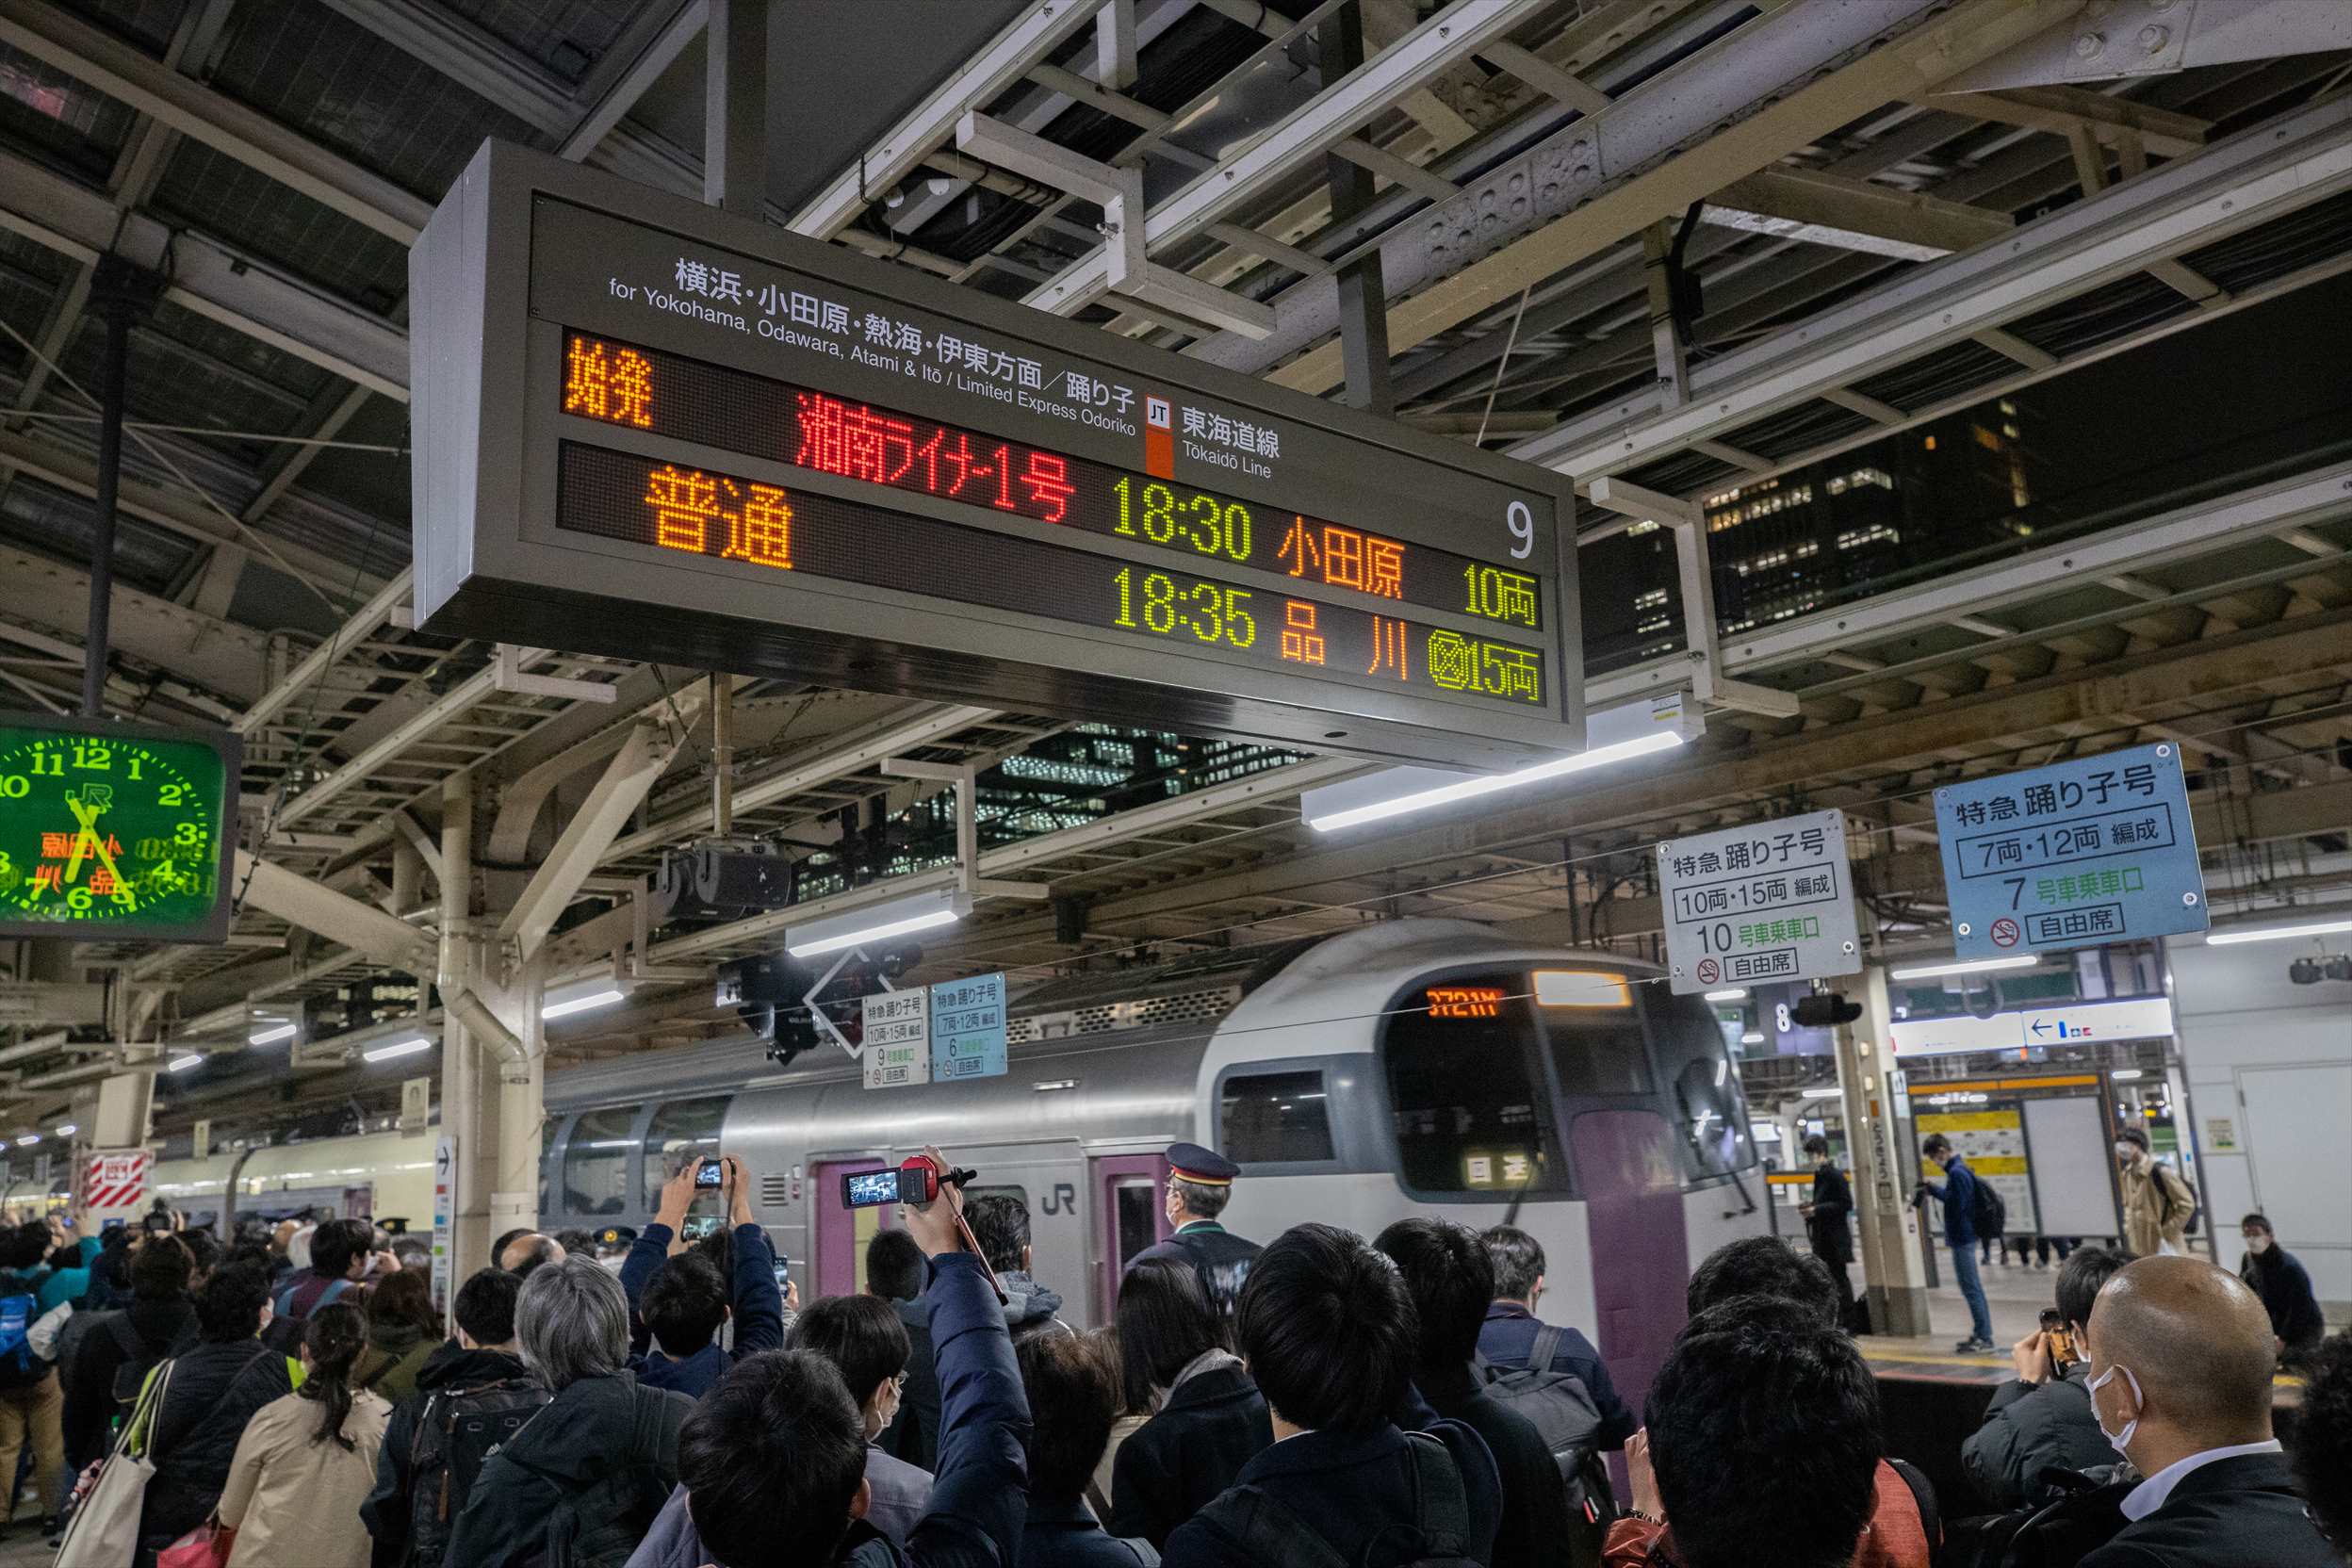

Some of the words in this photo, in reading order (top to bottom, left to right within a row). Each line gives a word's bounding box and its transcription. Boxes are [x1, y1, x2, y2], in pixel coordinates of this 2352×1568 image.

[609, 278, 637, 301] for
[644, 286, 751, 335] Yokohama,
[758, 319, 844, 360] Odawara,
[851, 345, 899, 373] Atami
[905, 361, 917, 378] &
[923, 364, 942, 384] Itō
[956, 376, 1013, 403] Limited
[1018, 391, 1077, 421] Express
[1081, 408, 1136, 437] Odoriko
[1151, 404, 1167, 421] JT
[1182, 406, 1281, 459] 東海道線
[1182, 439, 1238, 469] Tōkaidō
[1242, 456, 1272, 479] Line
[565, 336, 653, 429] 始発
[1113, 477, 1251, 561] 18:30
[1277, 515, 1405, 599] 小田原
[1463, 564, 1536, 626] 10両
[1507, 499, 1534, 559] 9
[645, 466, 793, 569] 普通
[1113, 567, 1256, 647] 18:35
[30, 753, 65, 776] 11
[73, 746, 111, 770] 12
[127, 759, 142, 780] 1
[158, 785, 182, 806] 2
[1956, 796, 2019, 826] 特急
[2024, 763, 2156, 816] 踊り子号
[174, 823, 198, 845] 3
[1978, 825, 2100, 868] 7両・12両
[2111, 818, 2159, 845] 編成
[1674, 852, 1723, 878] 特急
[1725, 828, 1825, 871] 踊り子号
[152, 860, 176, 881] 4
[25, 878, 51, 901] 7
[67, 888, 92, 909] 6
[1682, 878, 1787, 915] 10両・15両
[1794, 874, 1830, 897] 編成
[2003, 877, 2026, 910] 7
[2036, 867, 2144, 905] 号車乗車口
[1697, 923, 1732, 954] 10
[1739, 917, 1820, 948] 号車乗車口
[2040, 910, 2114, 938] 自由席
[1736, 953, 1790, 976] 自由席
[1775, 1004, 1790, 1032] 8
[877, 1049, 885, 1066] 9
[949, 1038, 957, 1056] 6
[1042, 1184, 1075, 1216] JR
